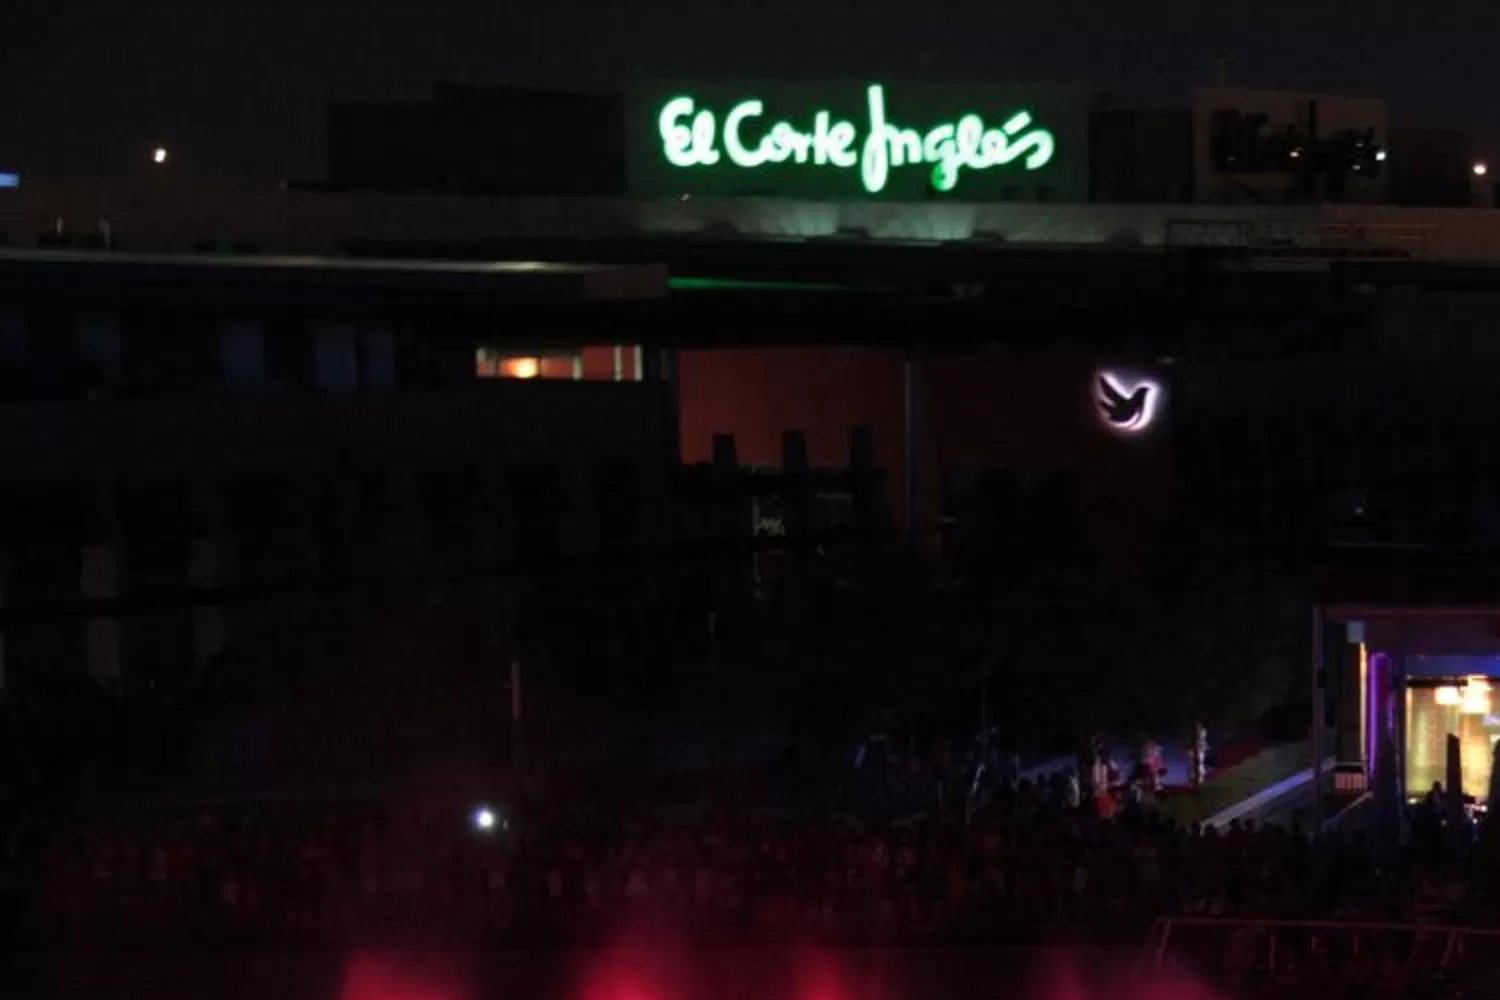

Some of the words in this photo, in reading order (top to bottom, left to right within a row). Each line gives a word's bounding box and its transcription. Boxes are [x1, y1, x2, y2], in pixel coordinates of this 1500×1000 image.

[659, 97, 719, 167] El
[723, 99, 858, 168] Corte
[861, 83, 1055, 193] Inglés
